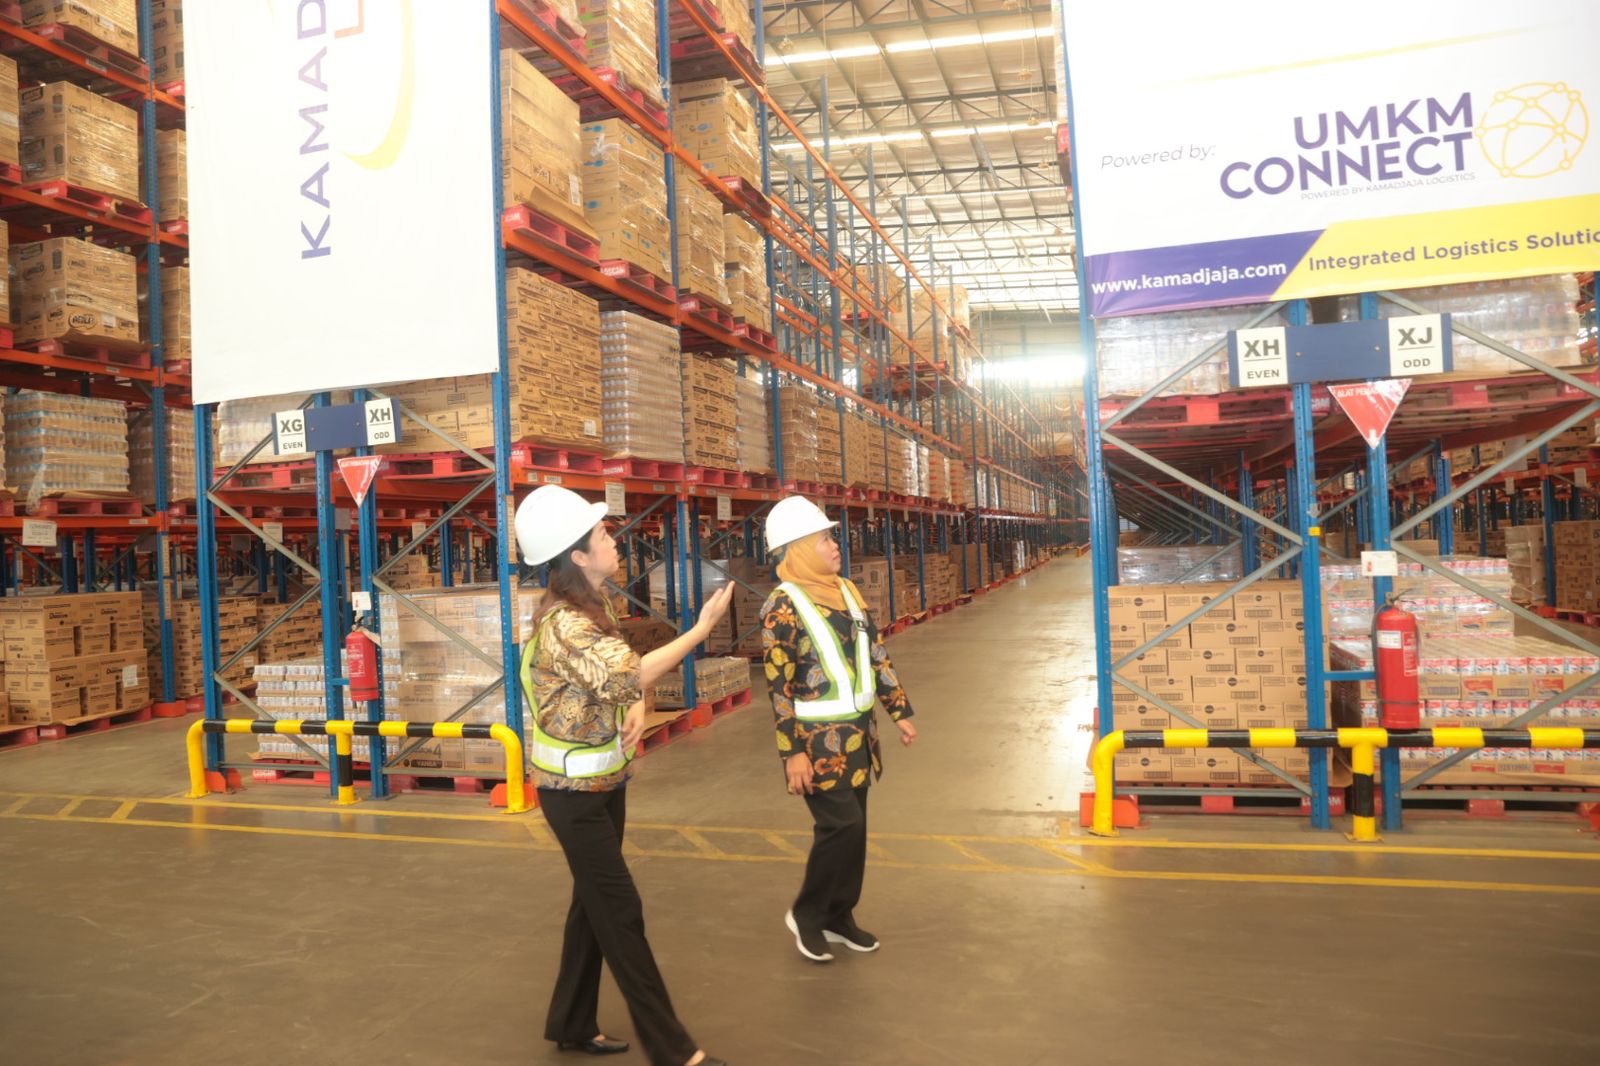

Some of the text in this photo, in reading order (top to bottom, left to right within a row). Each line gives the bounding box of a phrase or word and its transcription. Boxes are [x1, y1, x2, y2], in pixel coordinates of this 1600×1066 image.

[1294, 92, 1473, 149] UMKM
[1100, 145, 1184, 169] Powered
[1219, 131, 1473, 199] CONNECT
[1300, 172, 1476, 200] POWERED BY KAMADJAJA LOGISTICS
[1309, 246, 1415, 271] Integrated
[1423, 237, 1519, 261] Logistics
[1091, 262, 1287, 294] www.kamadjaja.com
[1398, 327, 1433, 347] XJ
[1243, 338, 1280, 358] XH
[1403, 358, 1431, 369] ODD
[1247, 368, 1280, 380] EVEN
[369, 408, 391, 423] XH
[280, 419, 303, 433] XG
[374, 431, 390, 440] ODD
[283, 442, 303, 450] EVEN
